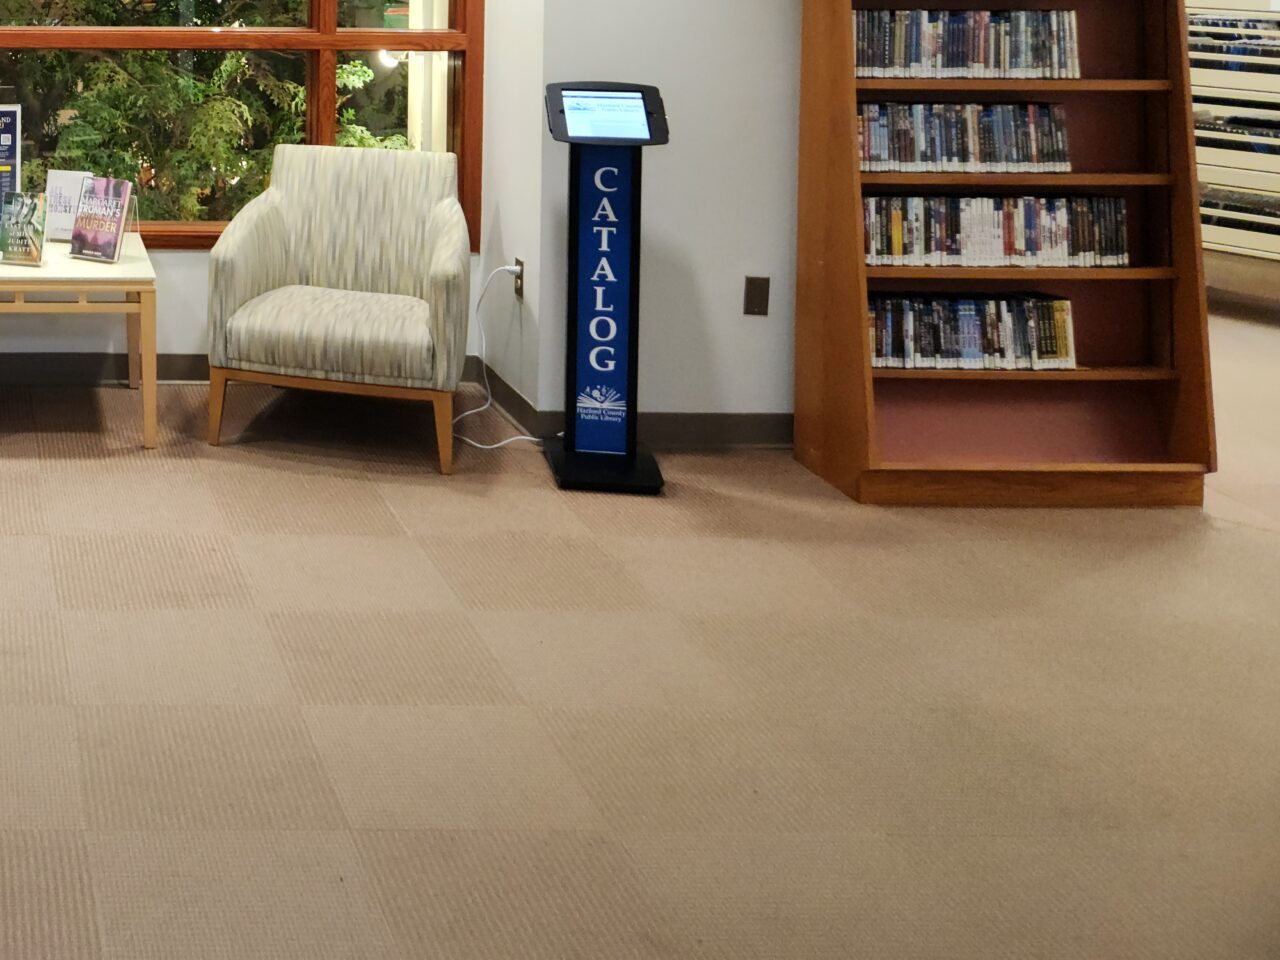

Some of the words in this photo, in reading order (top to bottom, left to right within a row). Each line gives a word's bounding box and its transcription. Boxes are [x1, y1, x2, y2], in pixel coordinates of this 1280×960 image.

[80, 195, 122, 208] MARGARET
[78, 204, 121, 218] TRUMAN'S
[77, 217, 117, 233] MURDER
[588, 166, 619, 372] CATALOG
[599, 414, 621, 422] Library
[602, 409, 625, 417] County
